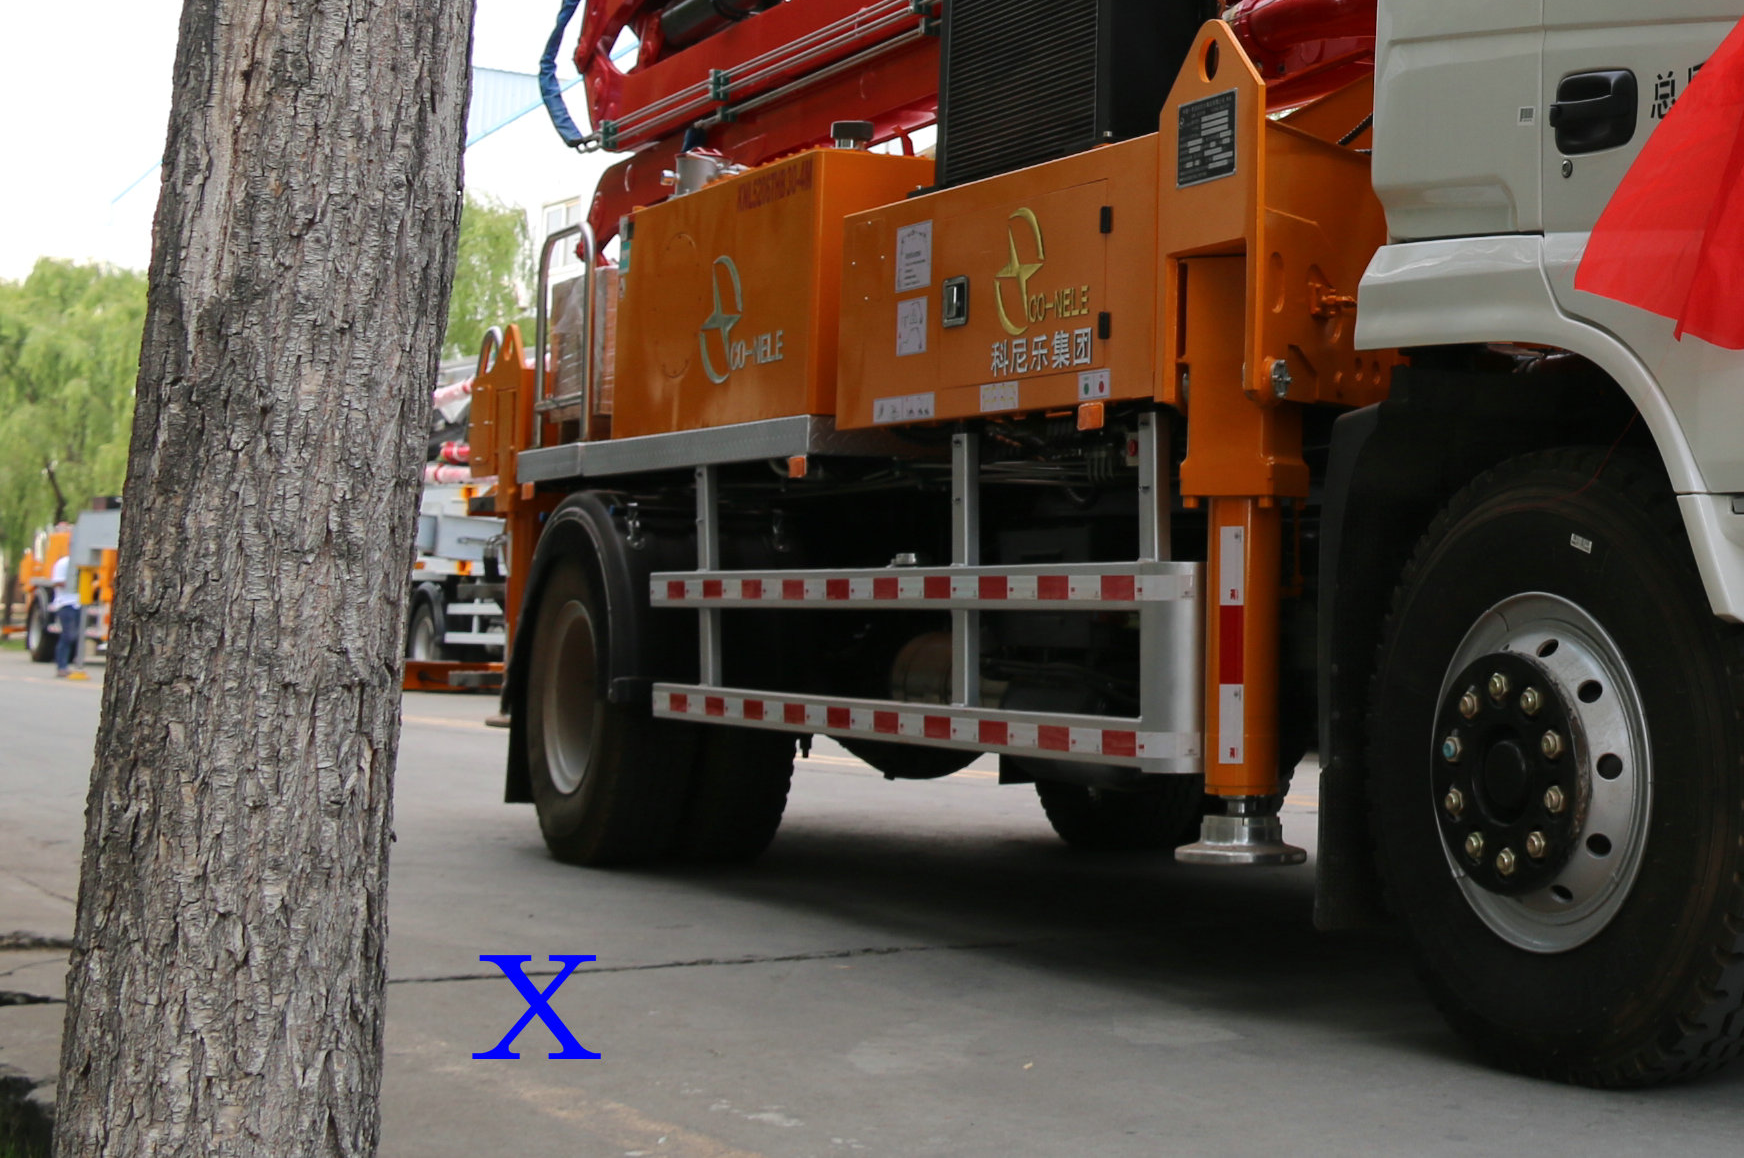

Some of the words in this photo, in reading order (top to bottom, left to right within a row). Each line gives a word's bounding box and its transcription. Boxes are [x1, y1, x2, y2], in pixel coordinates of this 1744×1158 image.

[1028, 284, 1090, 323] CO-NELE
[730, 330, 784, 371] CO-NELE
[990, 327, 1093, 378] 科尼乐集团
